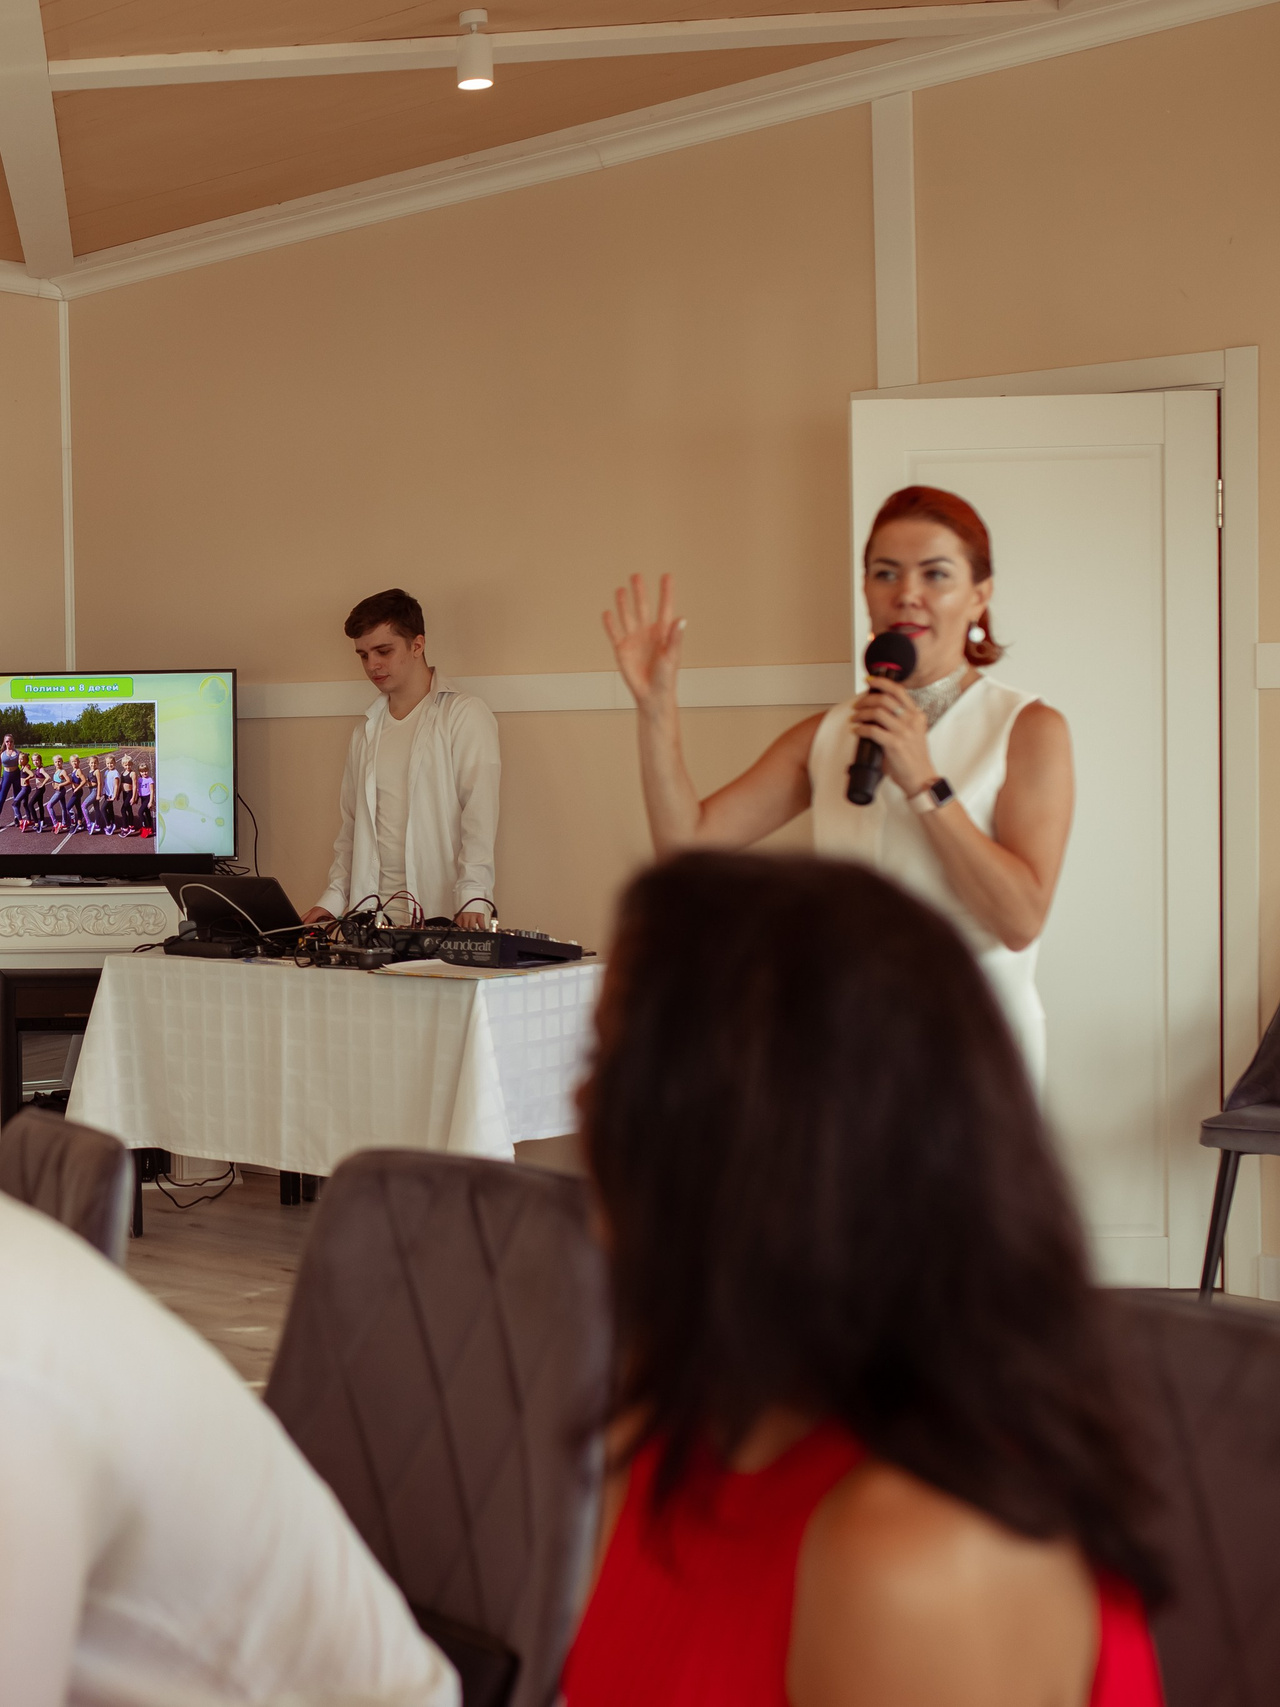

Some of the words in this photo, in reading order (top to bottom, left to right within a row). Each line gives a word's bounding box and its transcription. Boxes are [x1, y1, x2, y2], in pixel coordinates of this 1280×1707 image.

[24, 684, 66, 693] Полина
[78, 684, 85, 692] 8
[88, 683, 120, 693] детей
